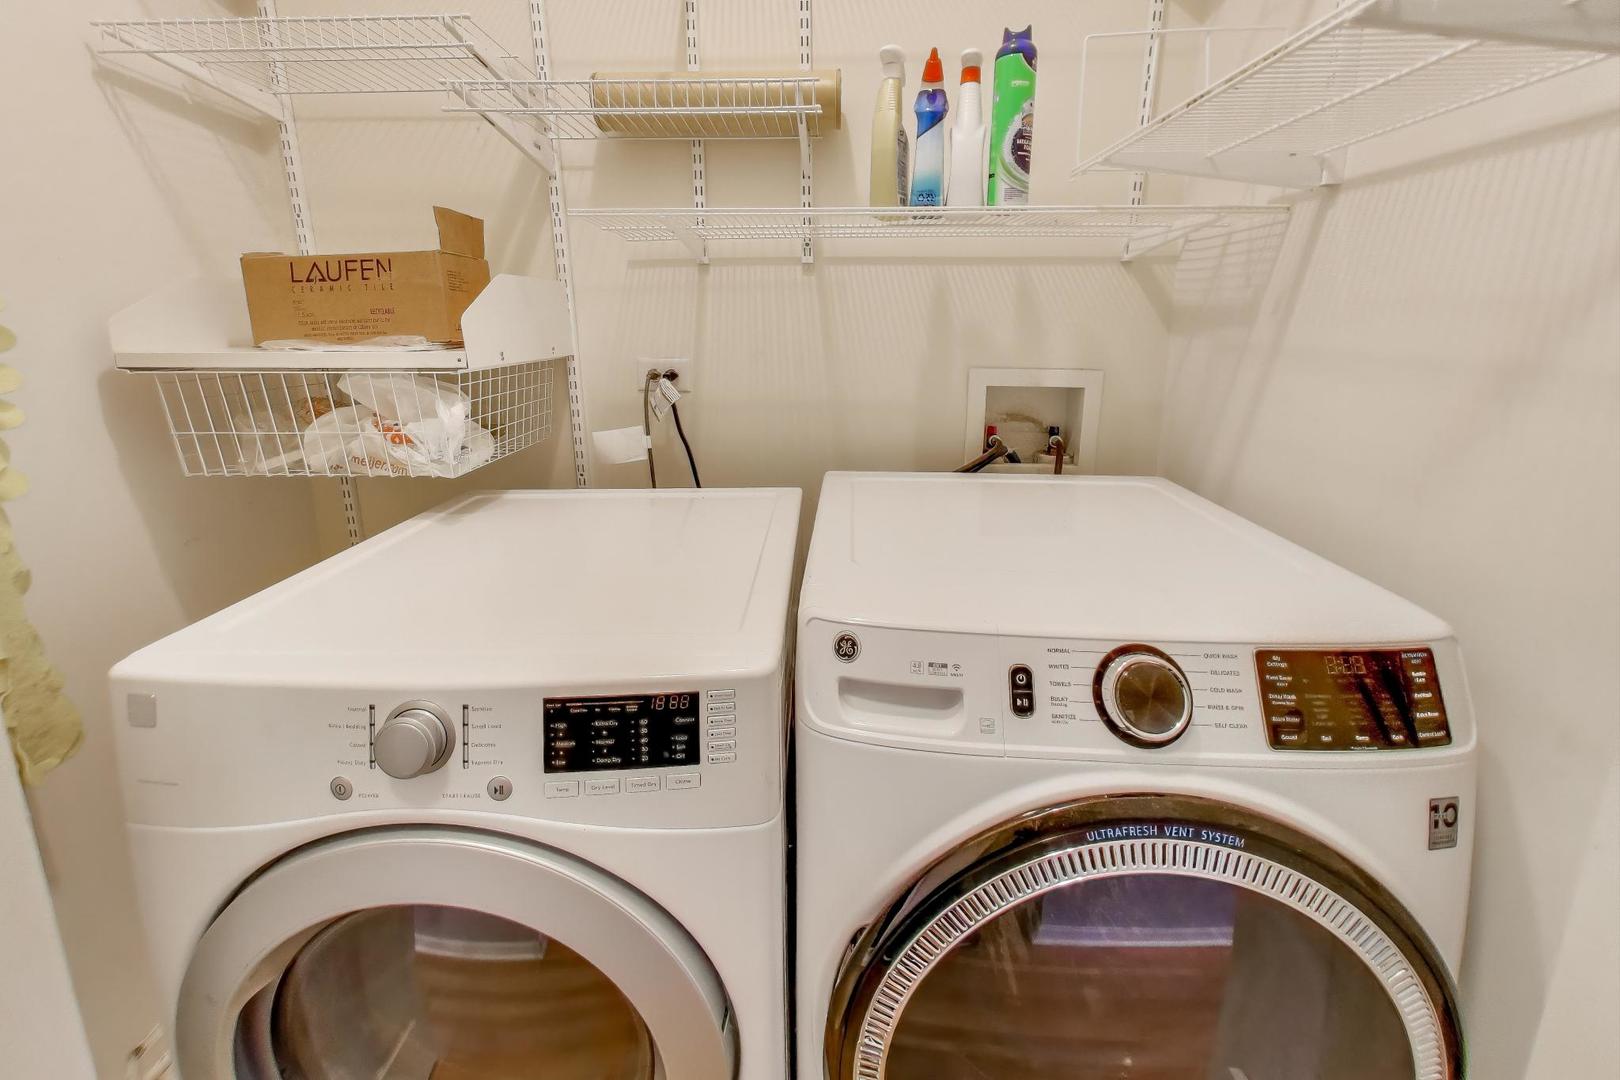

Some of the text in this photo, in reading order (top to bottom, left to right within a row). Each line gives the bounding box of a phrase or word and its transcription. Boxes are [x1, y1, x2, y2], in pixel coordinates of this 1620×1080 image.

[290, 258, 392, 282] LAUFEN
[351, 454, 409, 476] meijer.com
[1430, 802, 1458, 830] 10
[1086, 825, 1245, 848] ULTRAFRESH VENT SYSTEM
